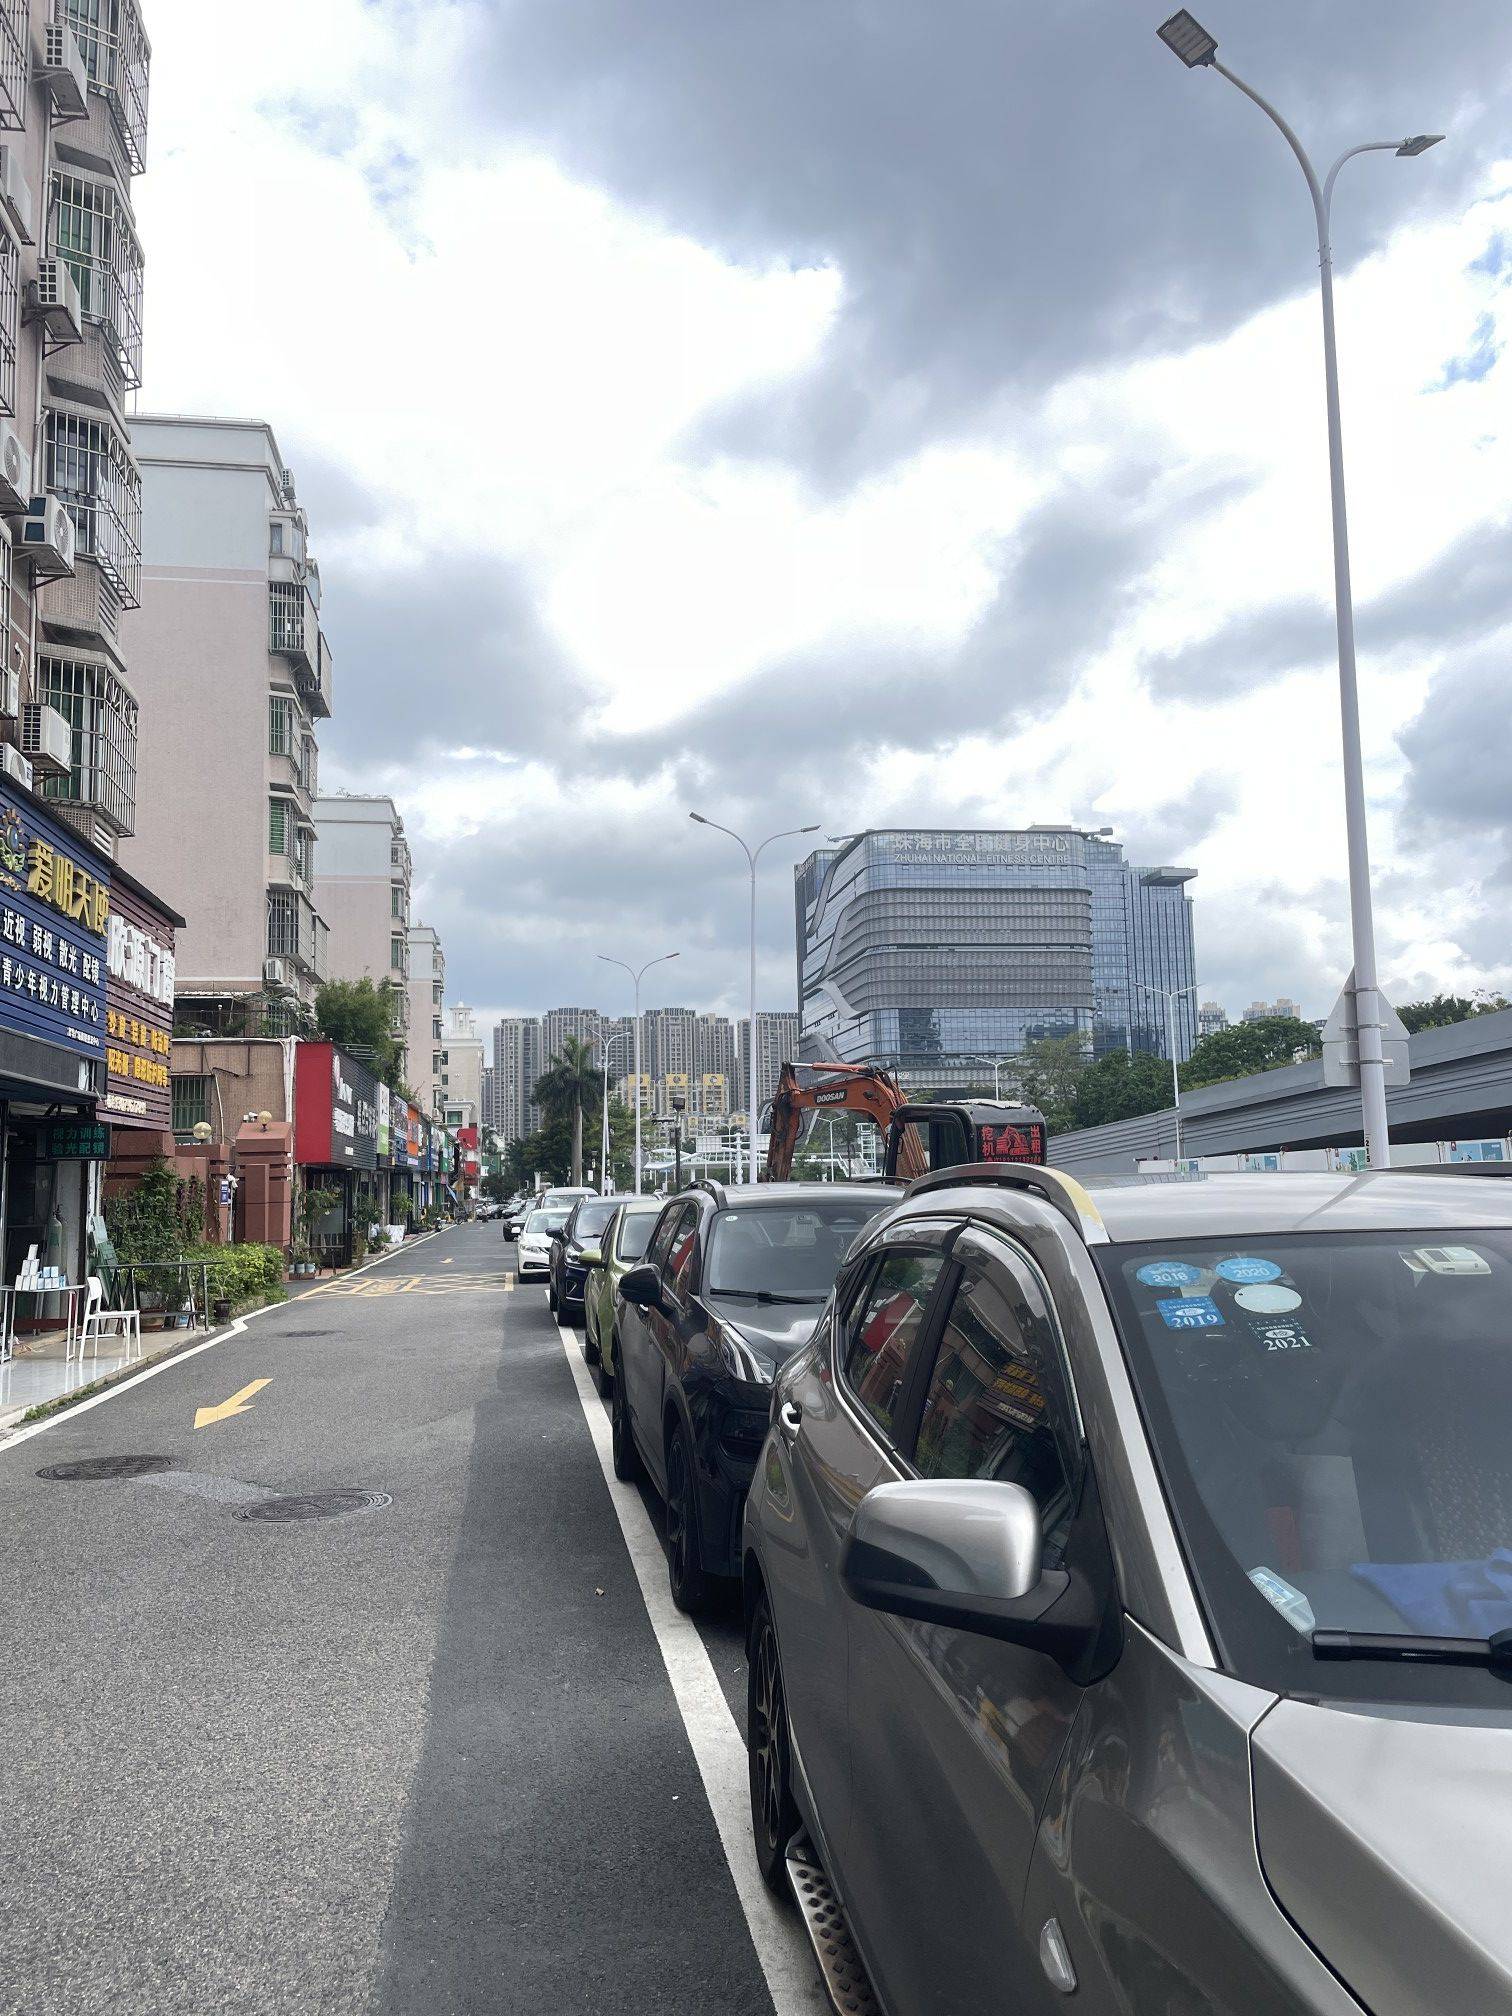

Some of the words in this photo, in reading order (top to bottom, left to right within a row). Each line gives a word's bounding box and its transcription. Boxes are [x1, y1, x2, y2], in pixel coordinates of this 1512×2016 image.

[894, 853, 932, 864] ZHUHAI
[933, 853, 982, 864] NATIONAL
[986, 853, 1026, 864] FITNESS
[1030, 853, 1070, 864] CENTRE
[28, 837, 109, 938] 爱明天使
[3, 908, 26, 947] 近视
[32, 923, 53, 961] 弱视
[59, 938, 78, 974] 散光
[82, 952, 100, 986] 配镜
[2, 957, 99, 1022] 青少年视力管理中心
[816, 1091, 845, 1103] DOOSAN
[1152, 1272, 1188, 1282] 2018
[1234, 1267, 1270, 1279] 2020
[1171, 1314, 1218, 1328] 2019
[1263, 1335, 1313, 1351] 2021
